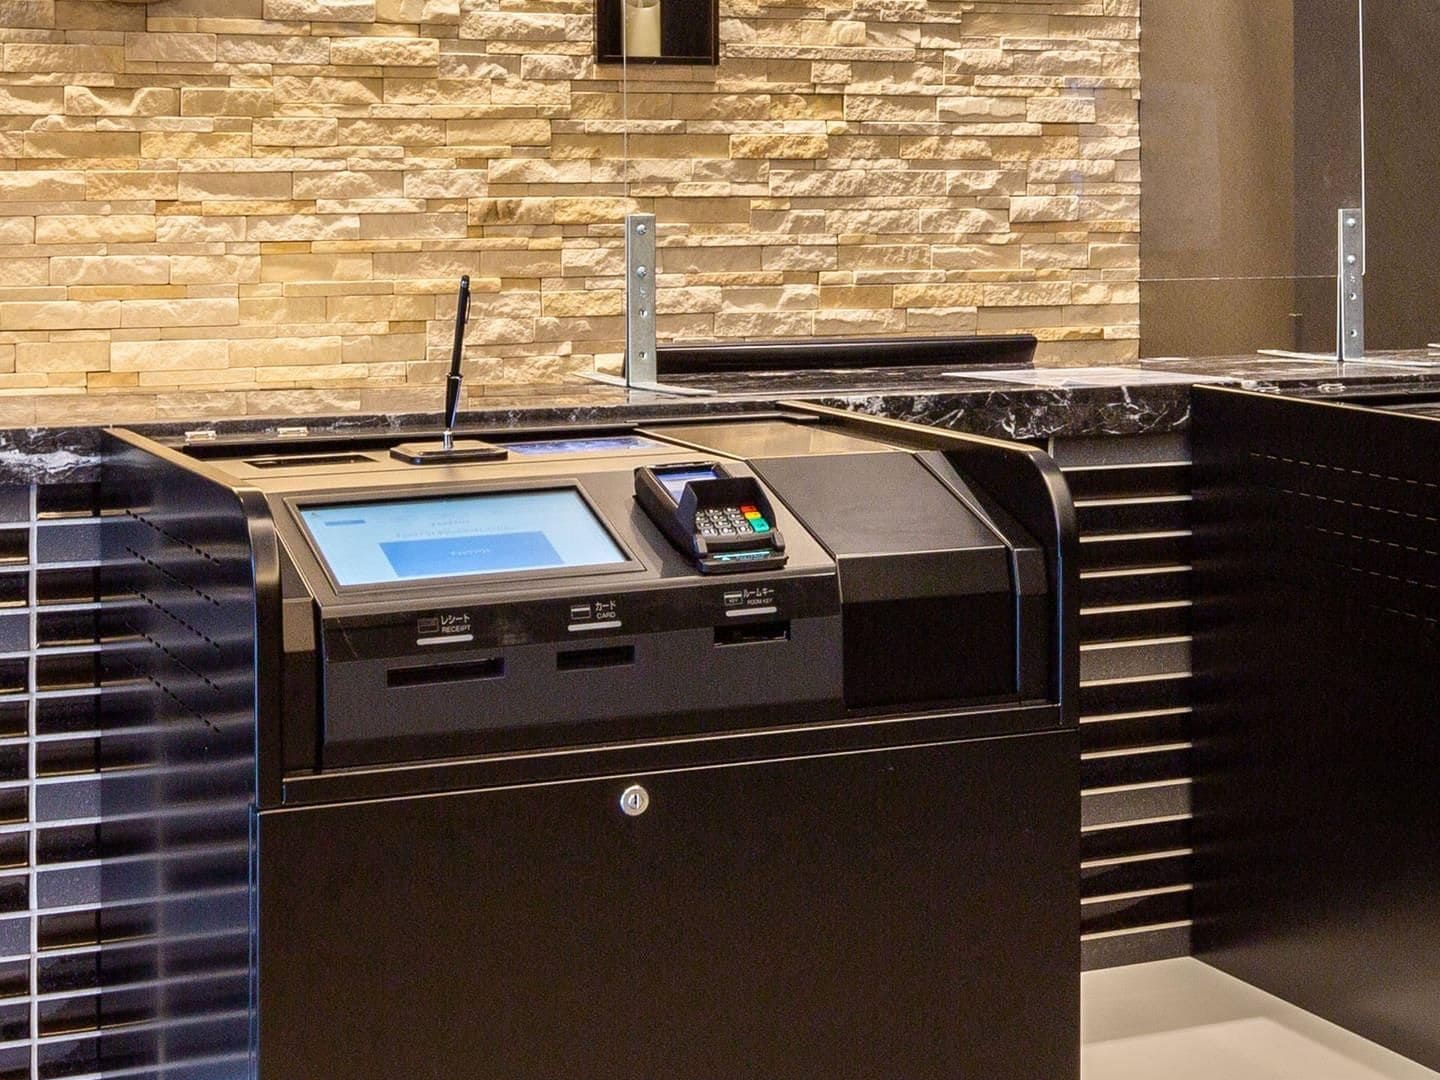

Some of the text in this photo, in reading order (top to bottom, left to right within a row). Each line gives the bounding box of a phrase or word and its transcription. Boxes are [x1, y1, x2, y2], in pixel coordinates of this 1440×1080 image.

[595, 600, 616, 611] カード
[440, 614, 471, 625] レシート
[596, 611, 616, 620] CARD
[441, 624, 471, 633] RECEIPT
